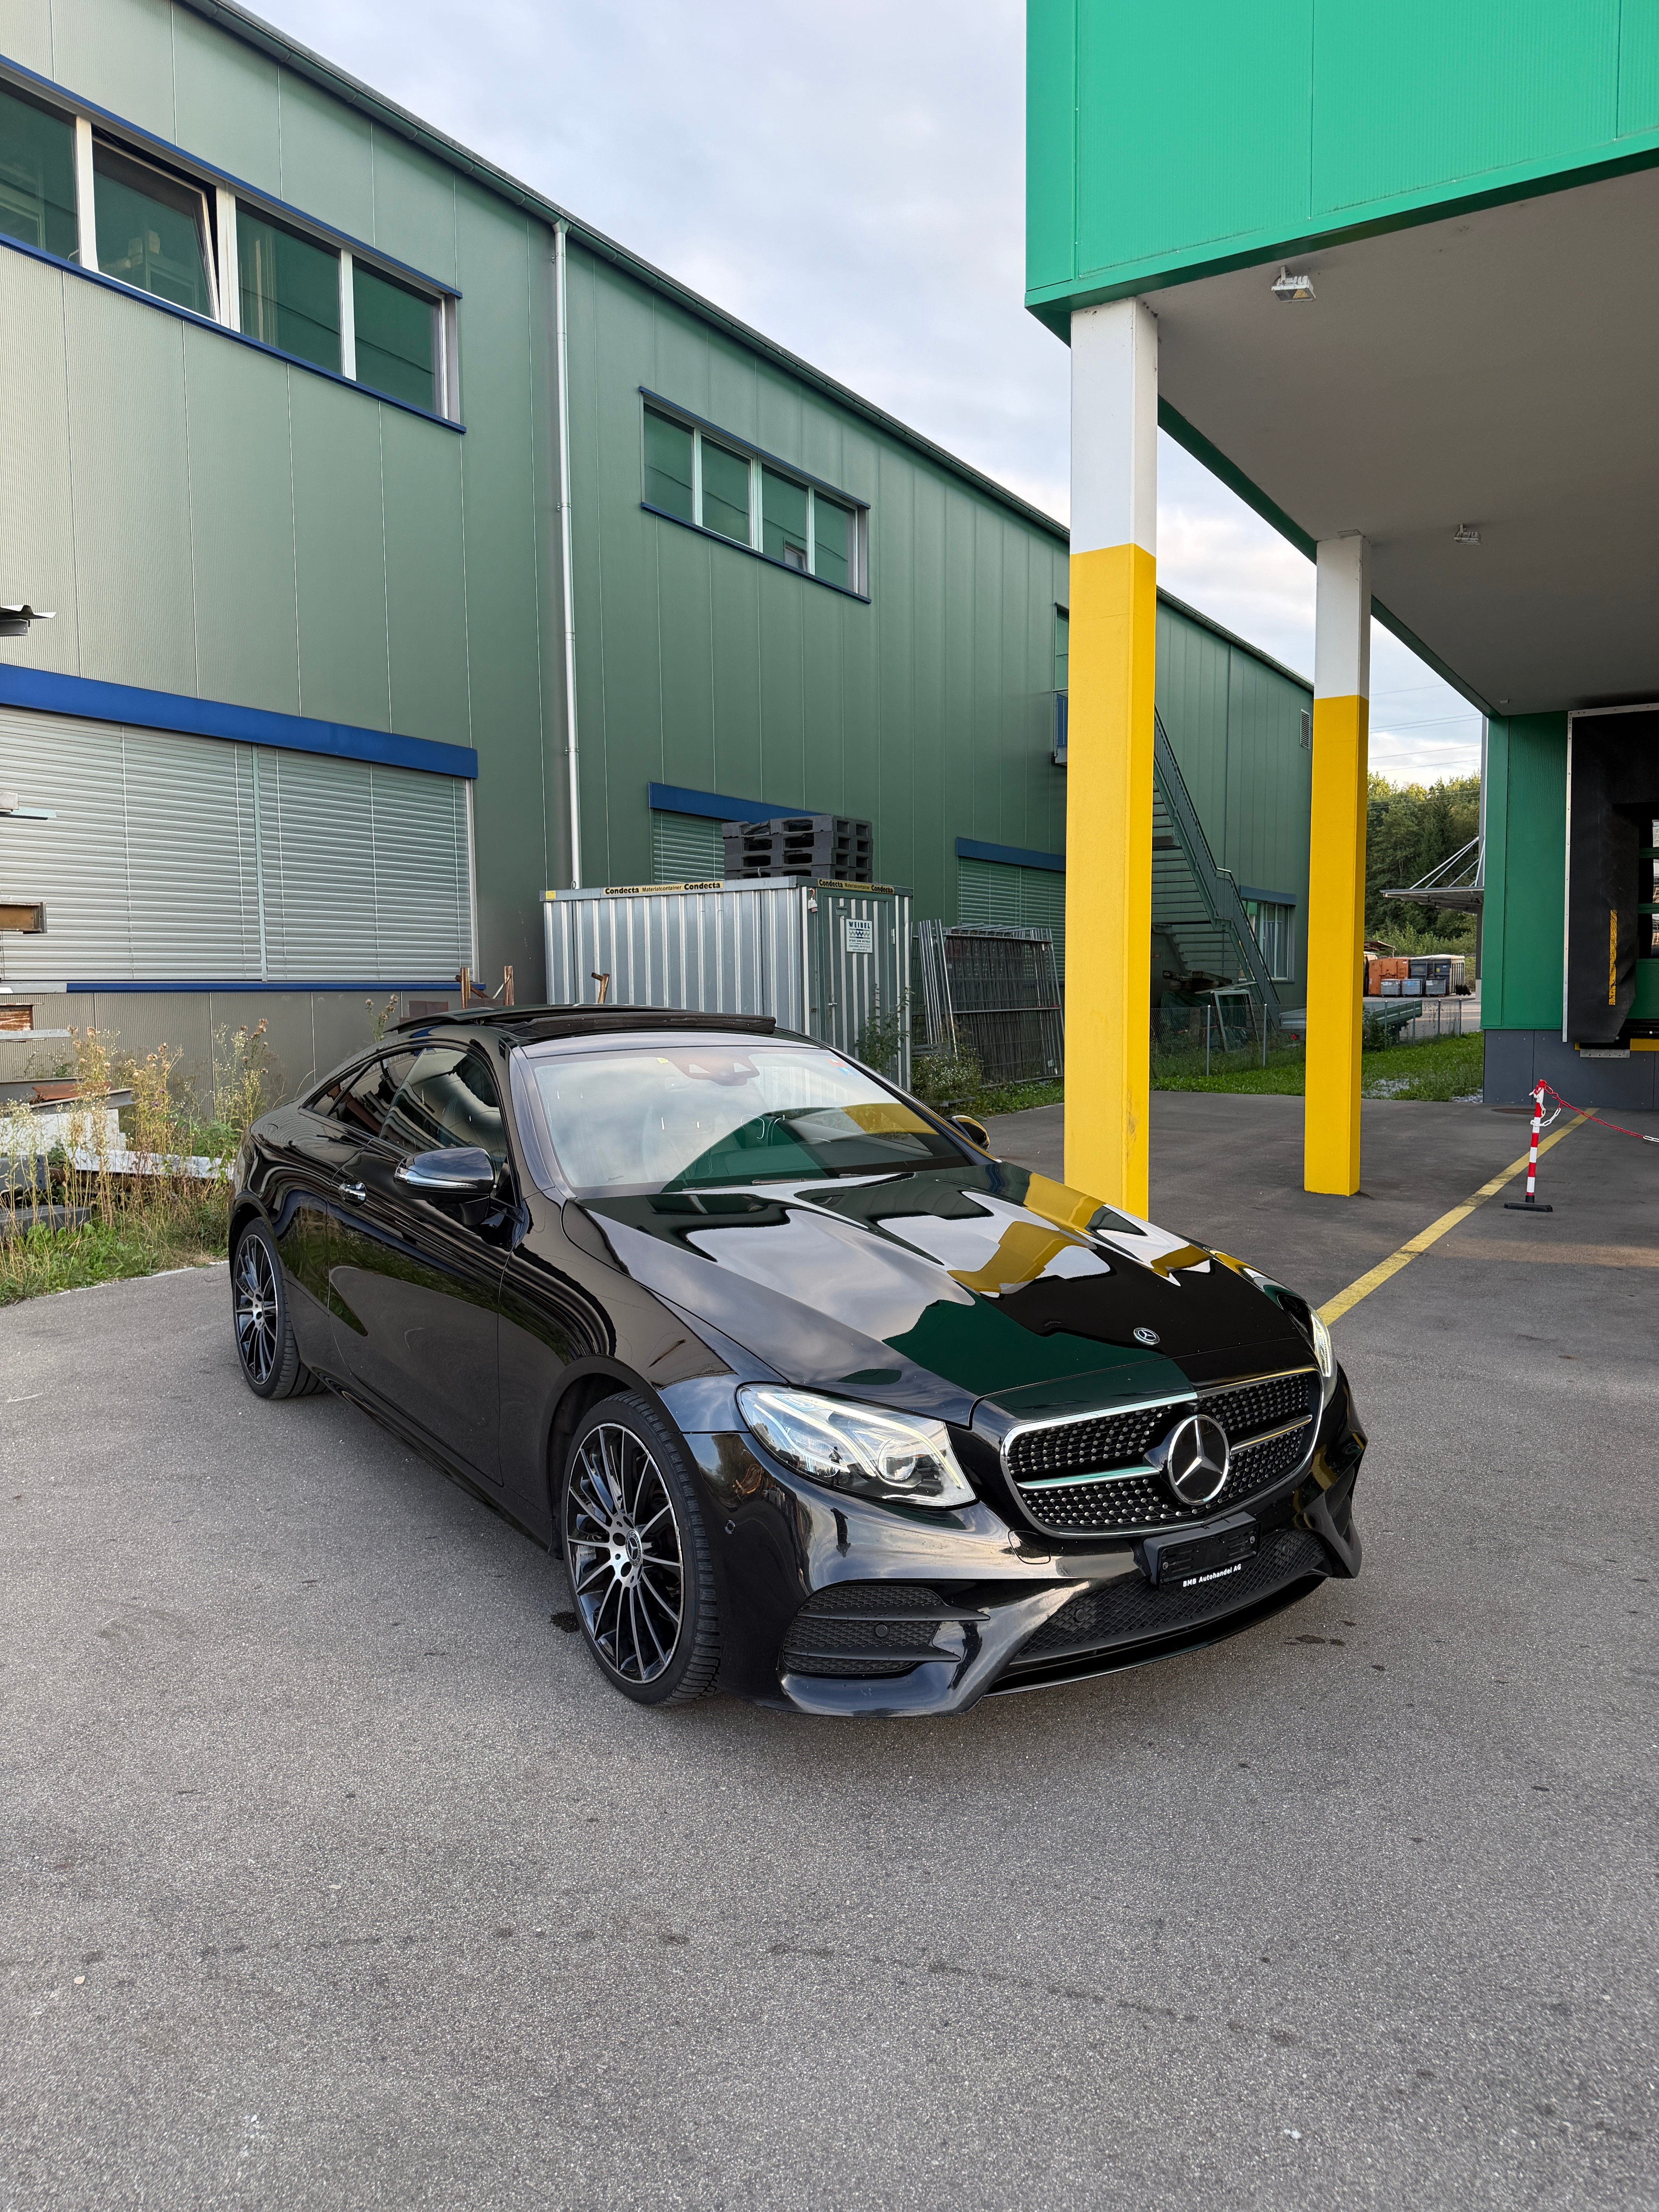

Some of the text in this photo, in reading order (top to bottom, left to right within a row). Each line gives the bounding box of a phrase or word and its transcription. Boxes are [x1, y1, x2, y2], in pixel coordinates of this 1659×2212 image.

[819, 879, 843, 888] Condecta
[871, 885, 893, 893] Condecta
[1183, 1564, 1241, 1587] BMB Autohandel AG
